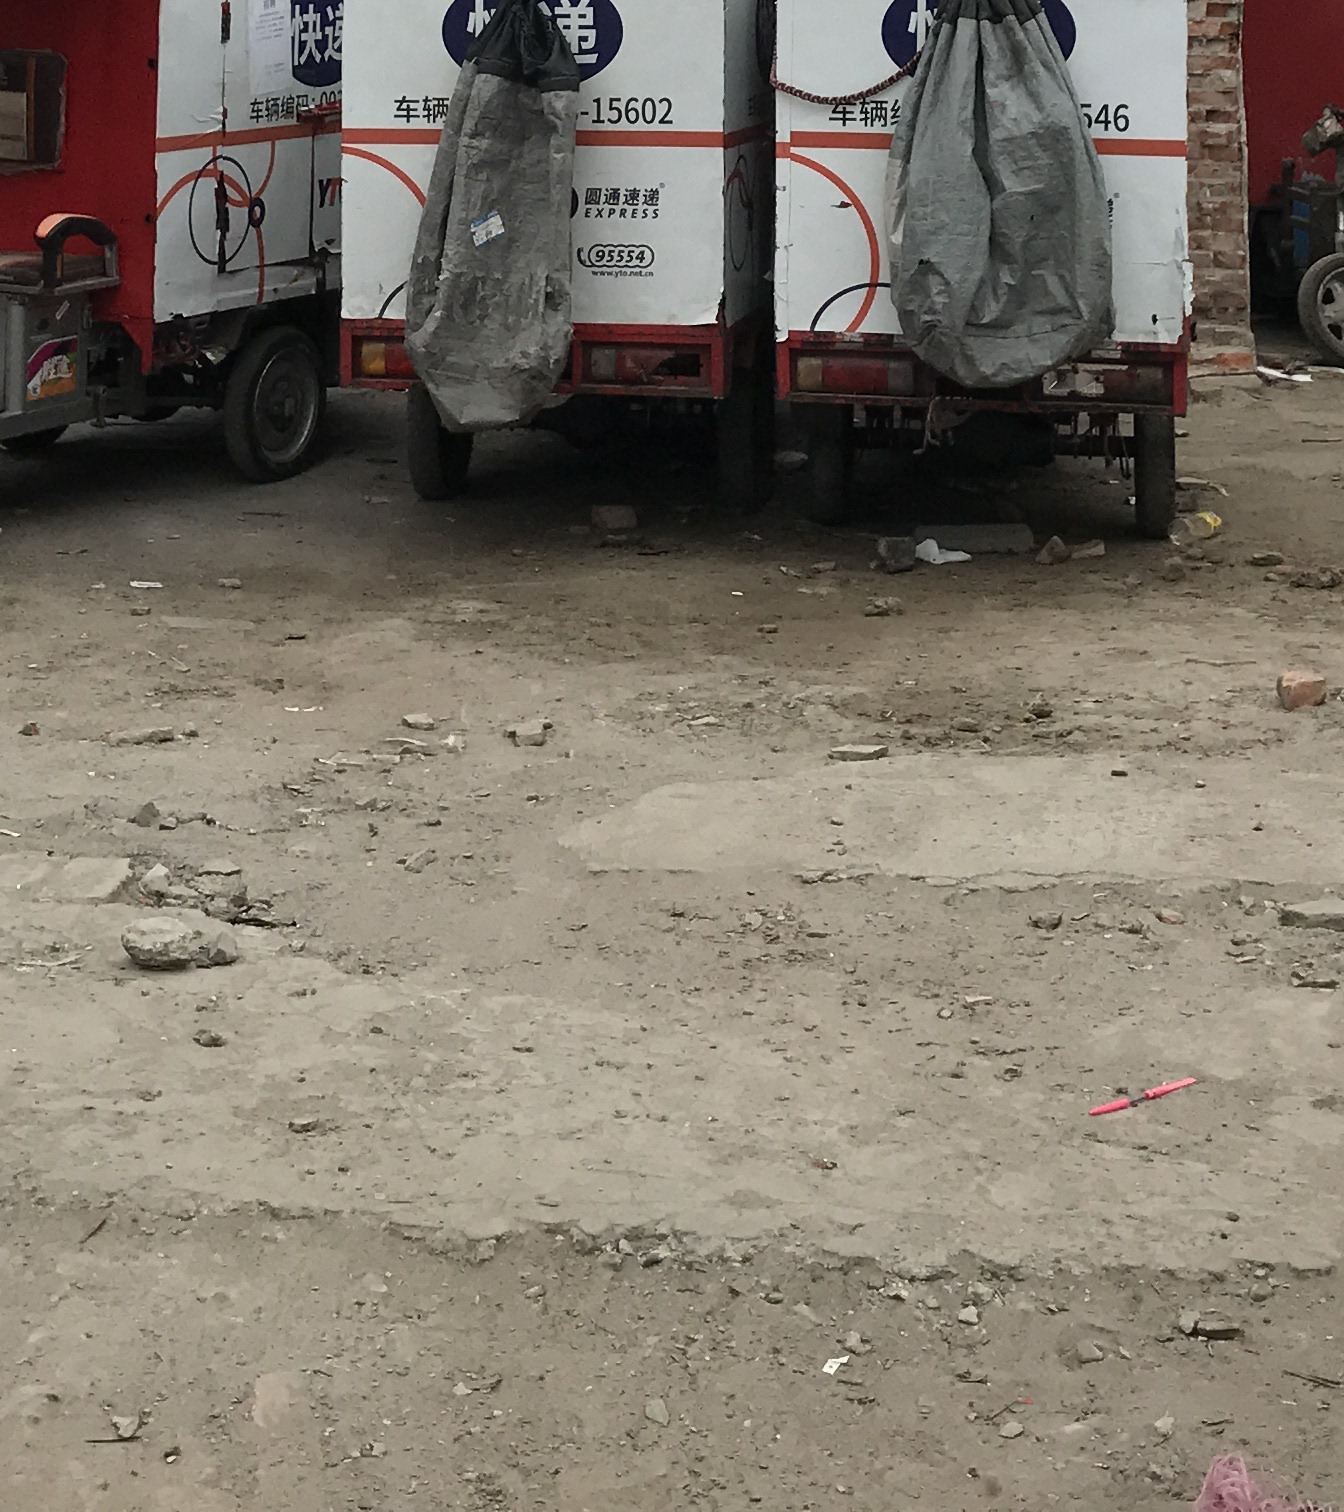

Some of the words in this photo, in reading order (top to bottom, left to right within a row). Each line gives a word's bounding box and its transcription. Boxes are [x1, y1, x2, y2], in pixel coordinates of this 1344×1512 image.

[584, 187, 660, 207] 圆通速递
[584, 207, 660, 220] EXPRESS
[594, 248, 647, 264] 95554
[591, 269, 654, 278] www.yto.net.cn
